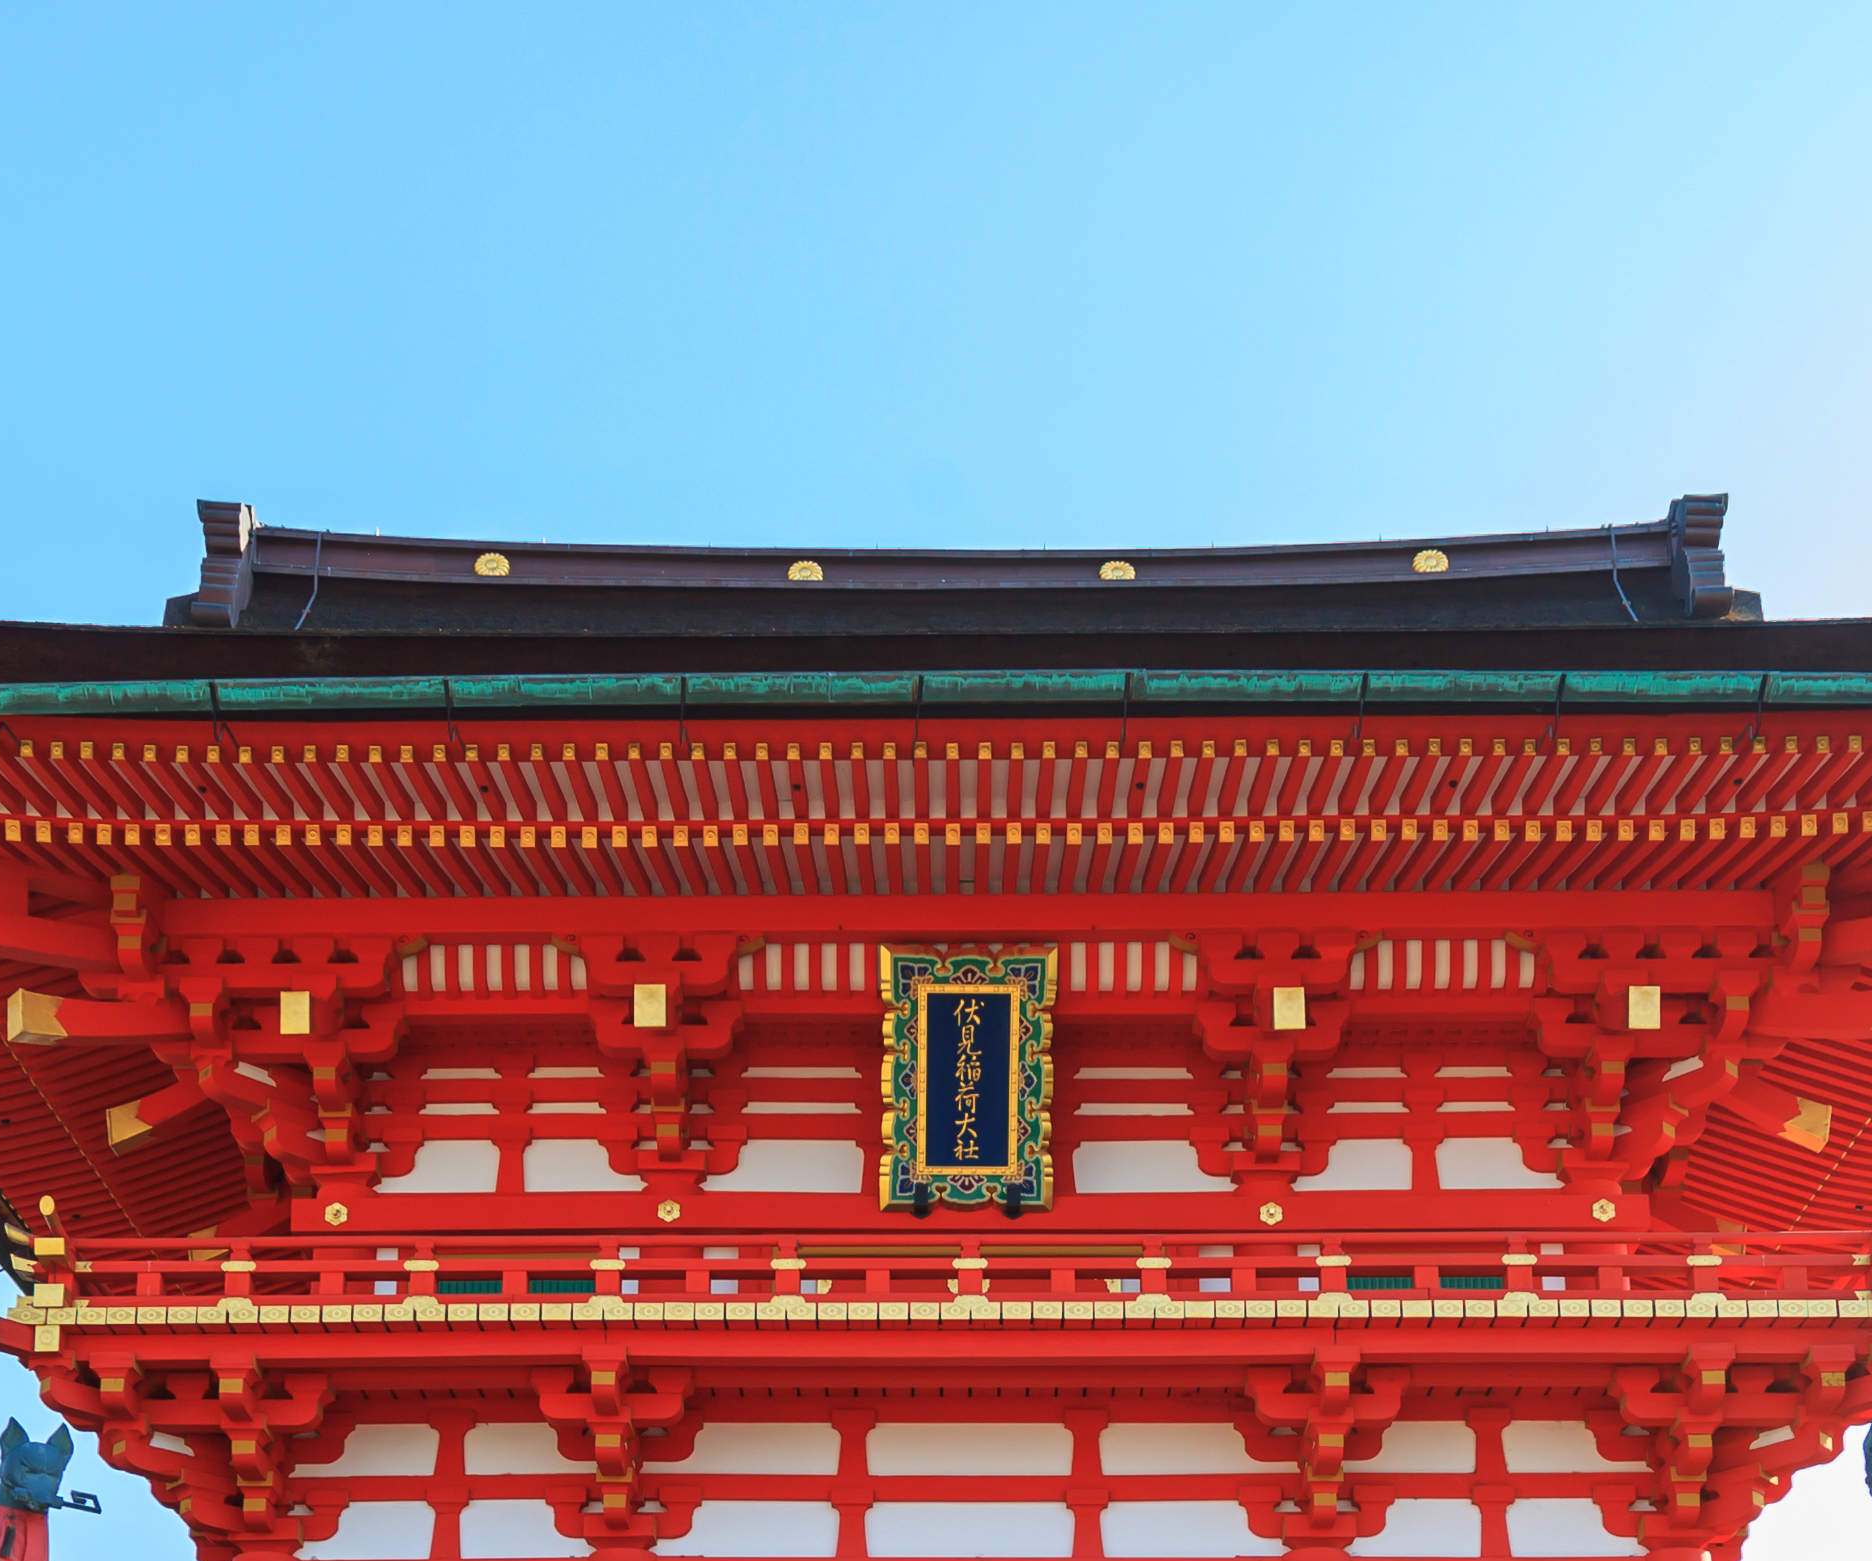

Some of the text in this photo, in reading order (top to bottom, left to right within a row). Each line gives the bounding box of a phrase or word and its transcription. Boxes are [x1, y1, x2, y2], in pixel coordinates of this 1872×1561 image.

[952, 998, 985, 1161] 伏見稲荷大社
